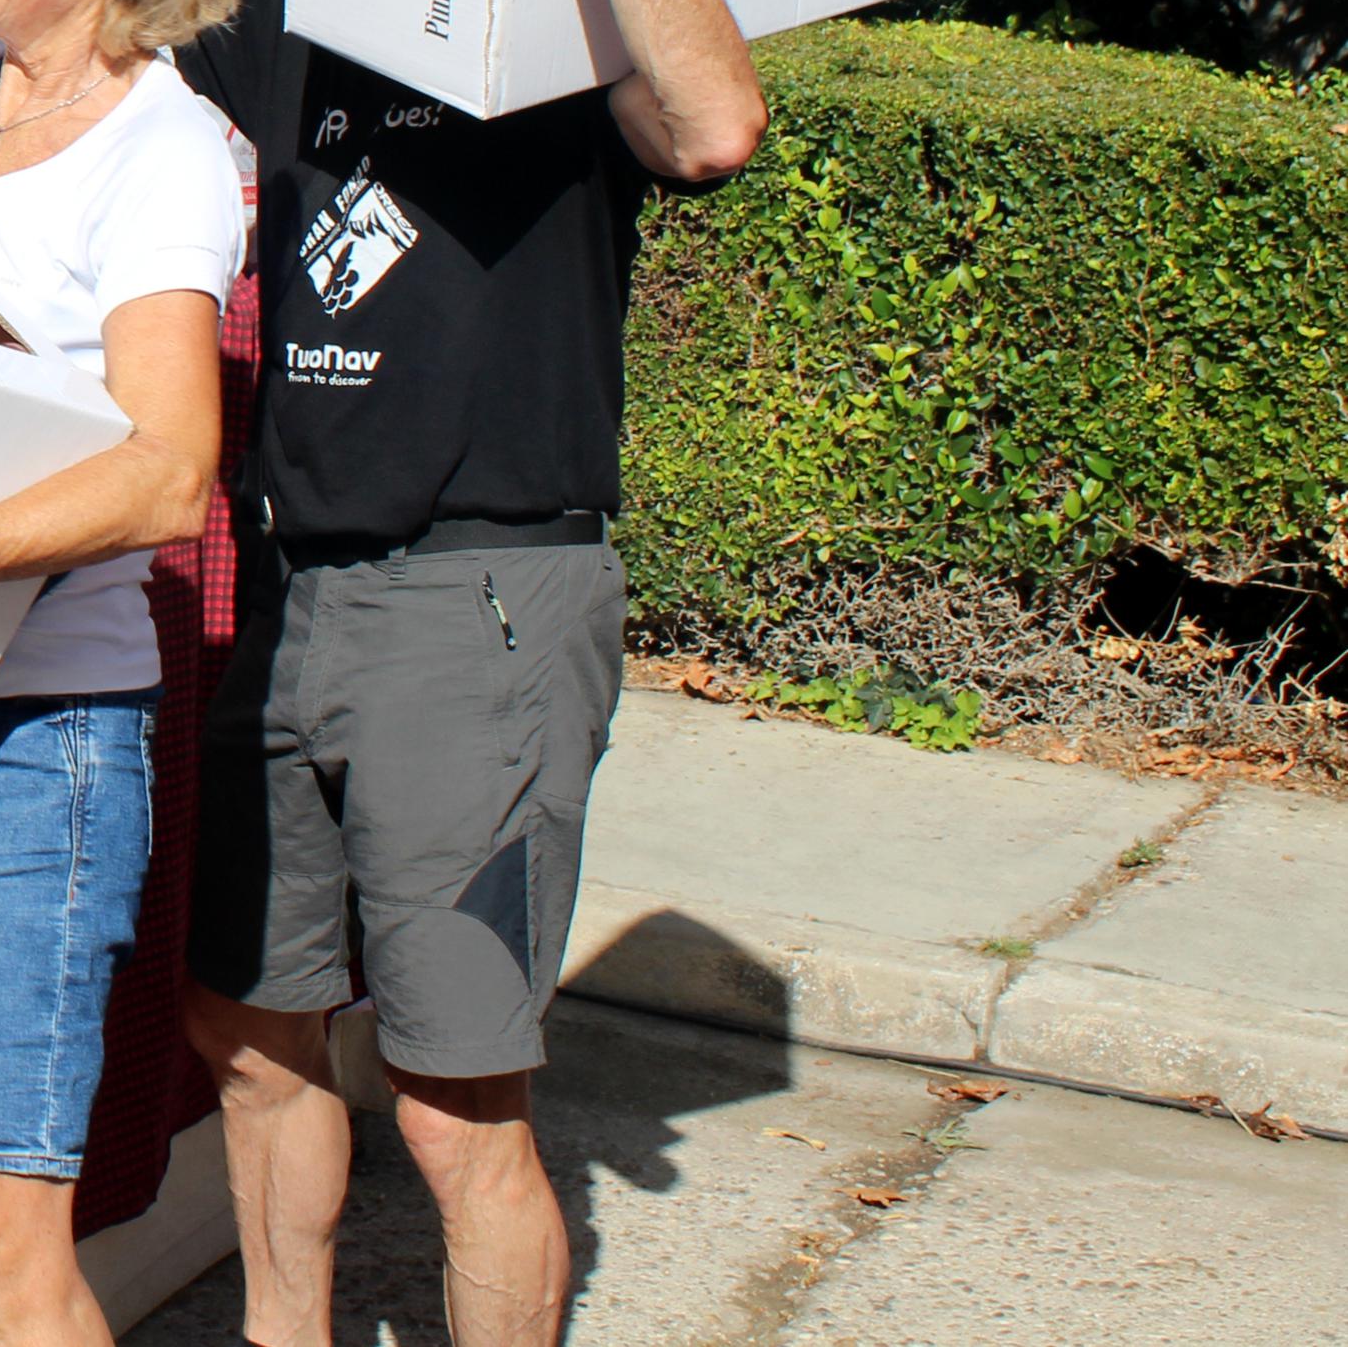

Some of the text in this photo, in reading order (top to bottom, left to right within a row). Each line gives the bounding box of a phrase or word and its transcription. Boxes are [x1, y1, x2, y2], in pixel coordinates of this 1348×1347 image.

[372, 180, 420, 245] ORBEA
[313, 371, 326, 385] to
[328, 373, 373, 387] discover
